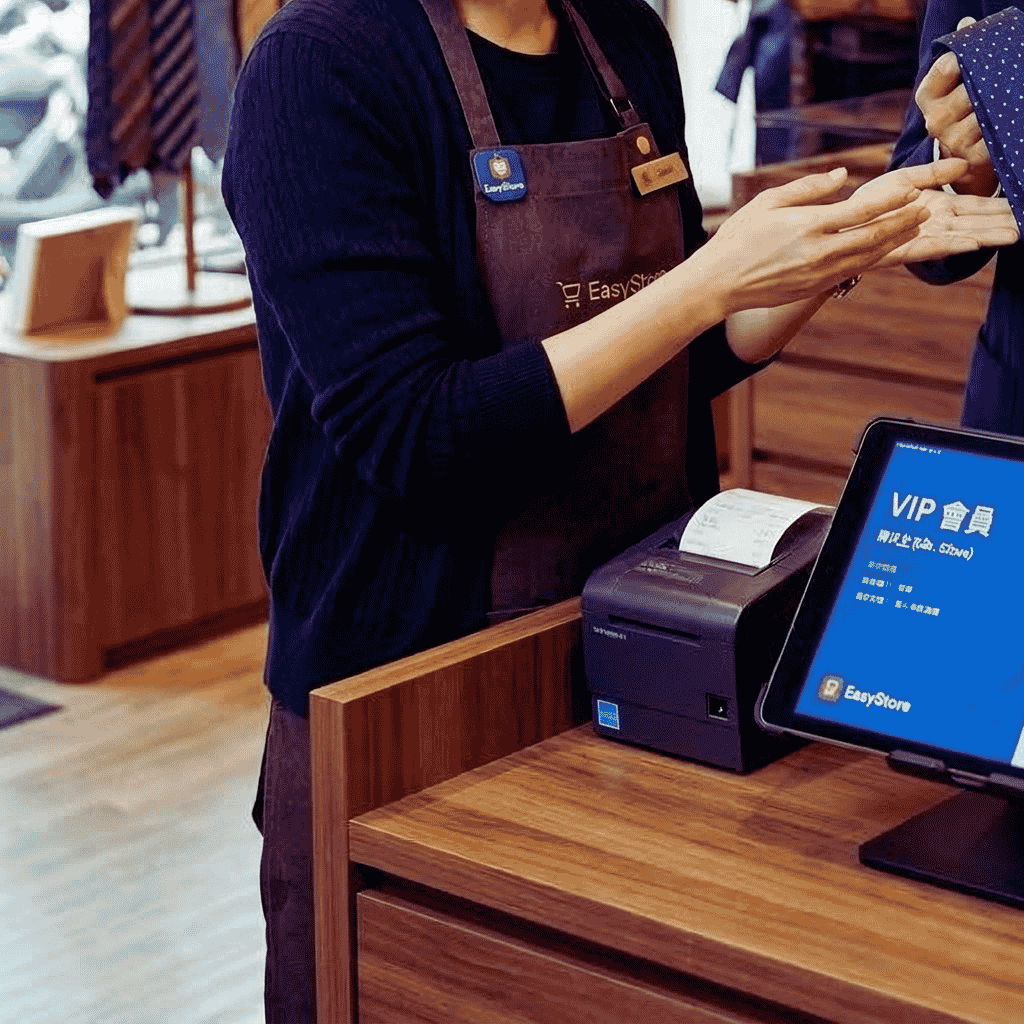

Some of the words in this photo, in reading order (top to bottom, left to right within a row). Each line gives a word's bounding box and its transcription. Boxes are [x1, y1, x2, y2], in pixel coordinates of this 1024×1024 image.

[891, 492, 937, 522] VIP
[940, 501, 995, 538] 會員
[843, 684, 912, 713] EasyStore
